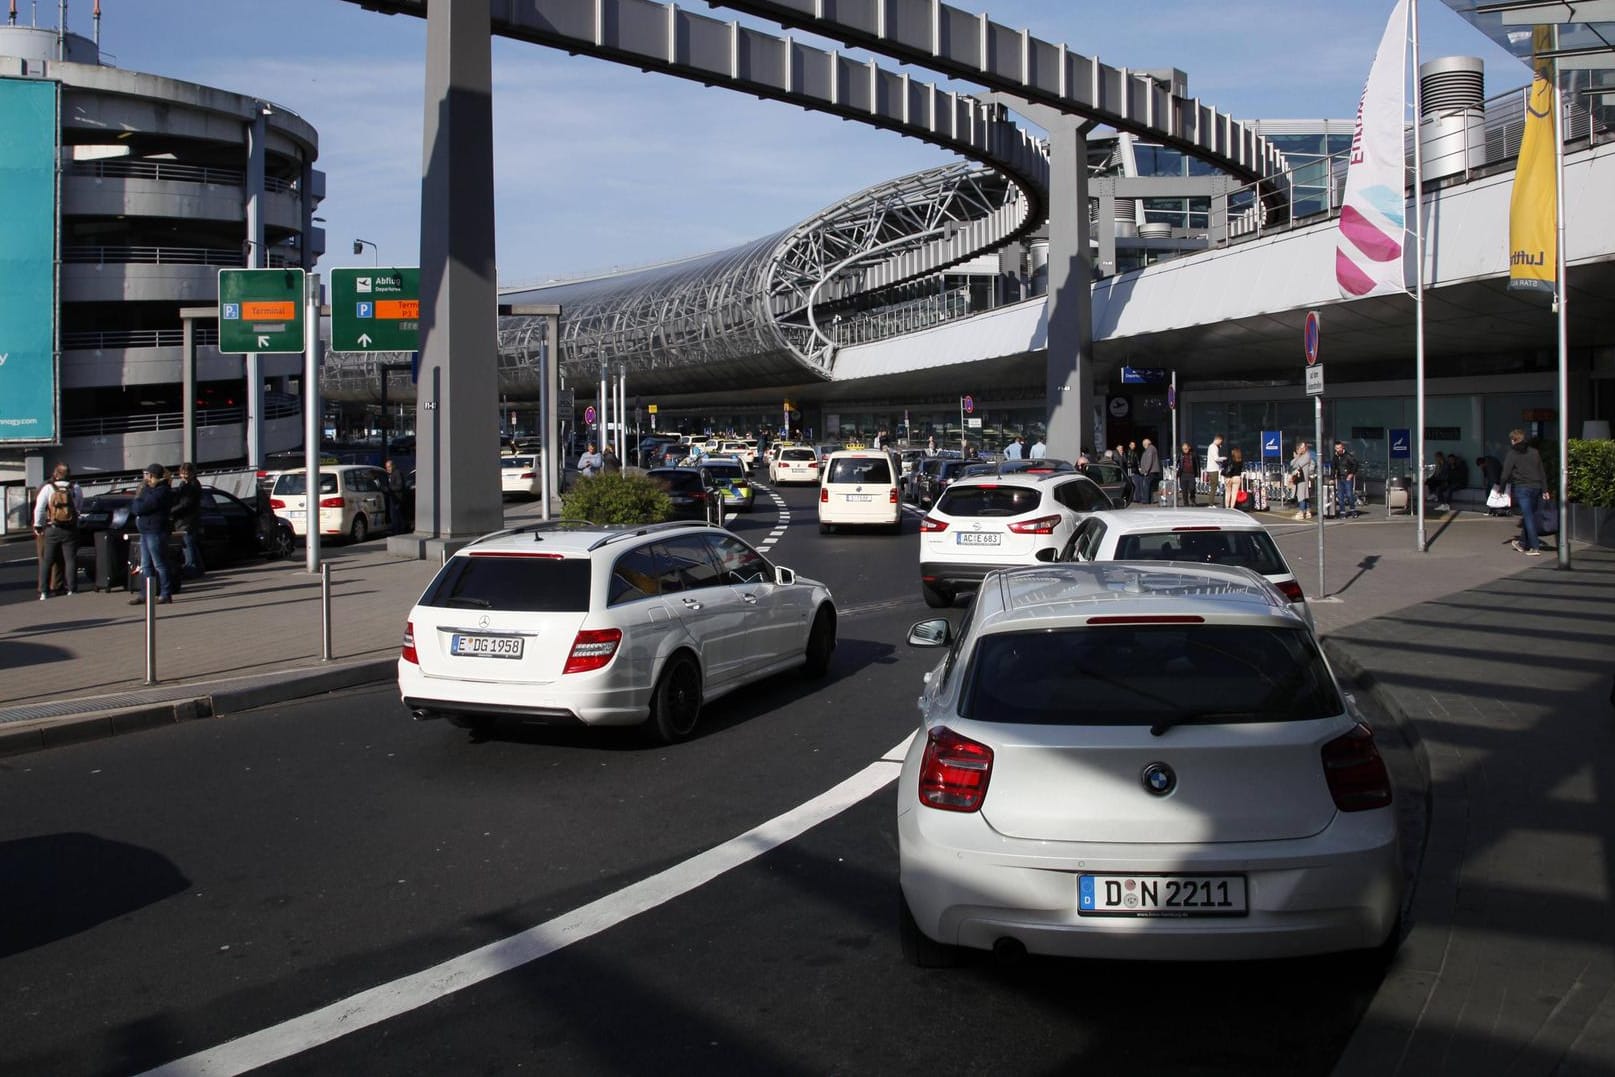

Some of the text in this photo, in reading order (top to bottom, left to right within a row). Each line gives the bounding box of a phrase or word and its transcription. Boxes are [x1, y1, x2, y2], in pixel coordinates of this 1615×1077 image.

[375, 277, 401, 286] Abflug
[251, 306, 286, 316] Terminal
[360, 304, 368, 316] P
[963, 534, 998, 543] AC E 683
[459, 637, 519, 653] E DG 1958
[1105, 880, 1122, 906] D
[1141, 880, 1159, 906] N
[1165, 880, 1233, 907] 2211
